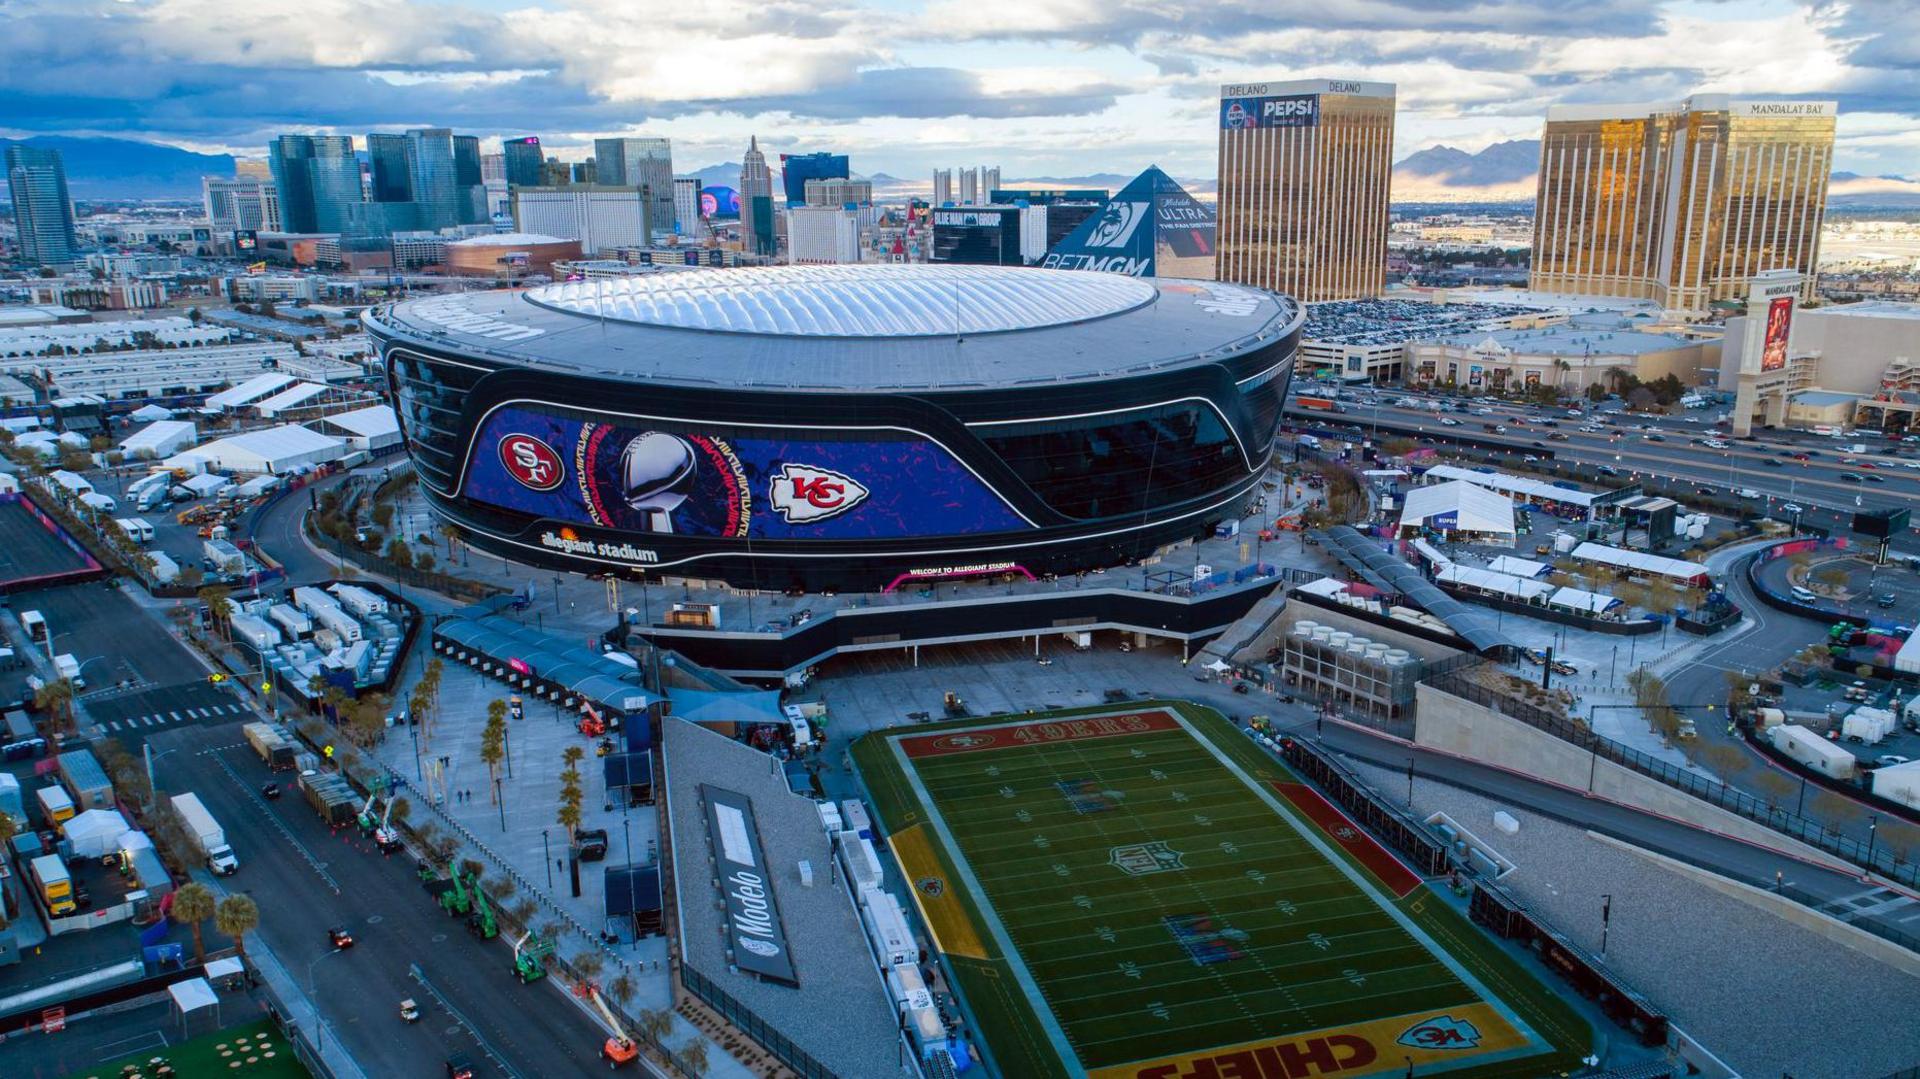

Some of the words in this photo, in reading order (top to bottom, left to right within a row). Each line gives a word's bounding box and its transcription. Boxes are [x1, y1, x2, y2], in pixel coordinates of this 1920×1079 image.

[1229, 84, 1268, 97] DELANO
[1329, 81, 1361, 93] DELANO
[1264, 100, 1313, 117] PEPSI
[1751, 104, 1804, 114] MANDALAY
[1806, 104, 1824, 114] BAY
[1158, 208, 1208, 220] ULTRA
[512, 441, 553, 483] SF
[791, 477, 845, 508] KC
[541, 531, 597, 555] allegiant
[598, 543, 659, 563] stadium
[910, 567, 942, 576] WELCOME
[953, 564, 987, 573] ALLEGIANT
[988, 561, 1016, 570] STADIUM
[1013, 715, 1150, 744] 49ERS
[728, 870, 775, 938] Modelo
[1411, 1026, 1467, 1045] KC
